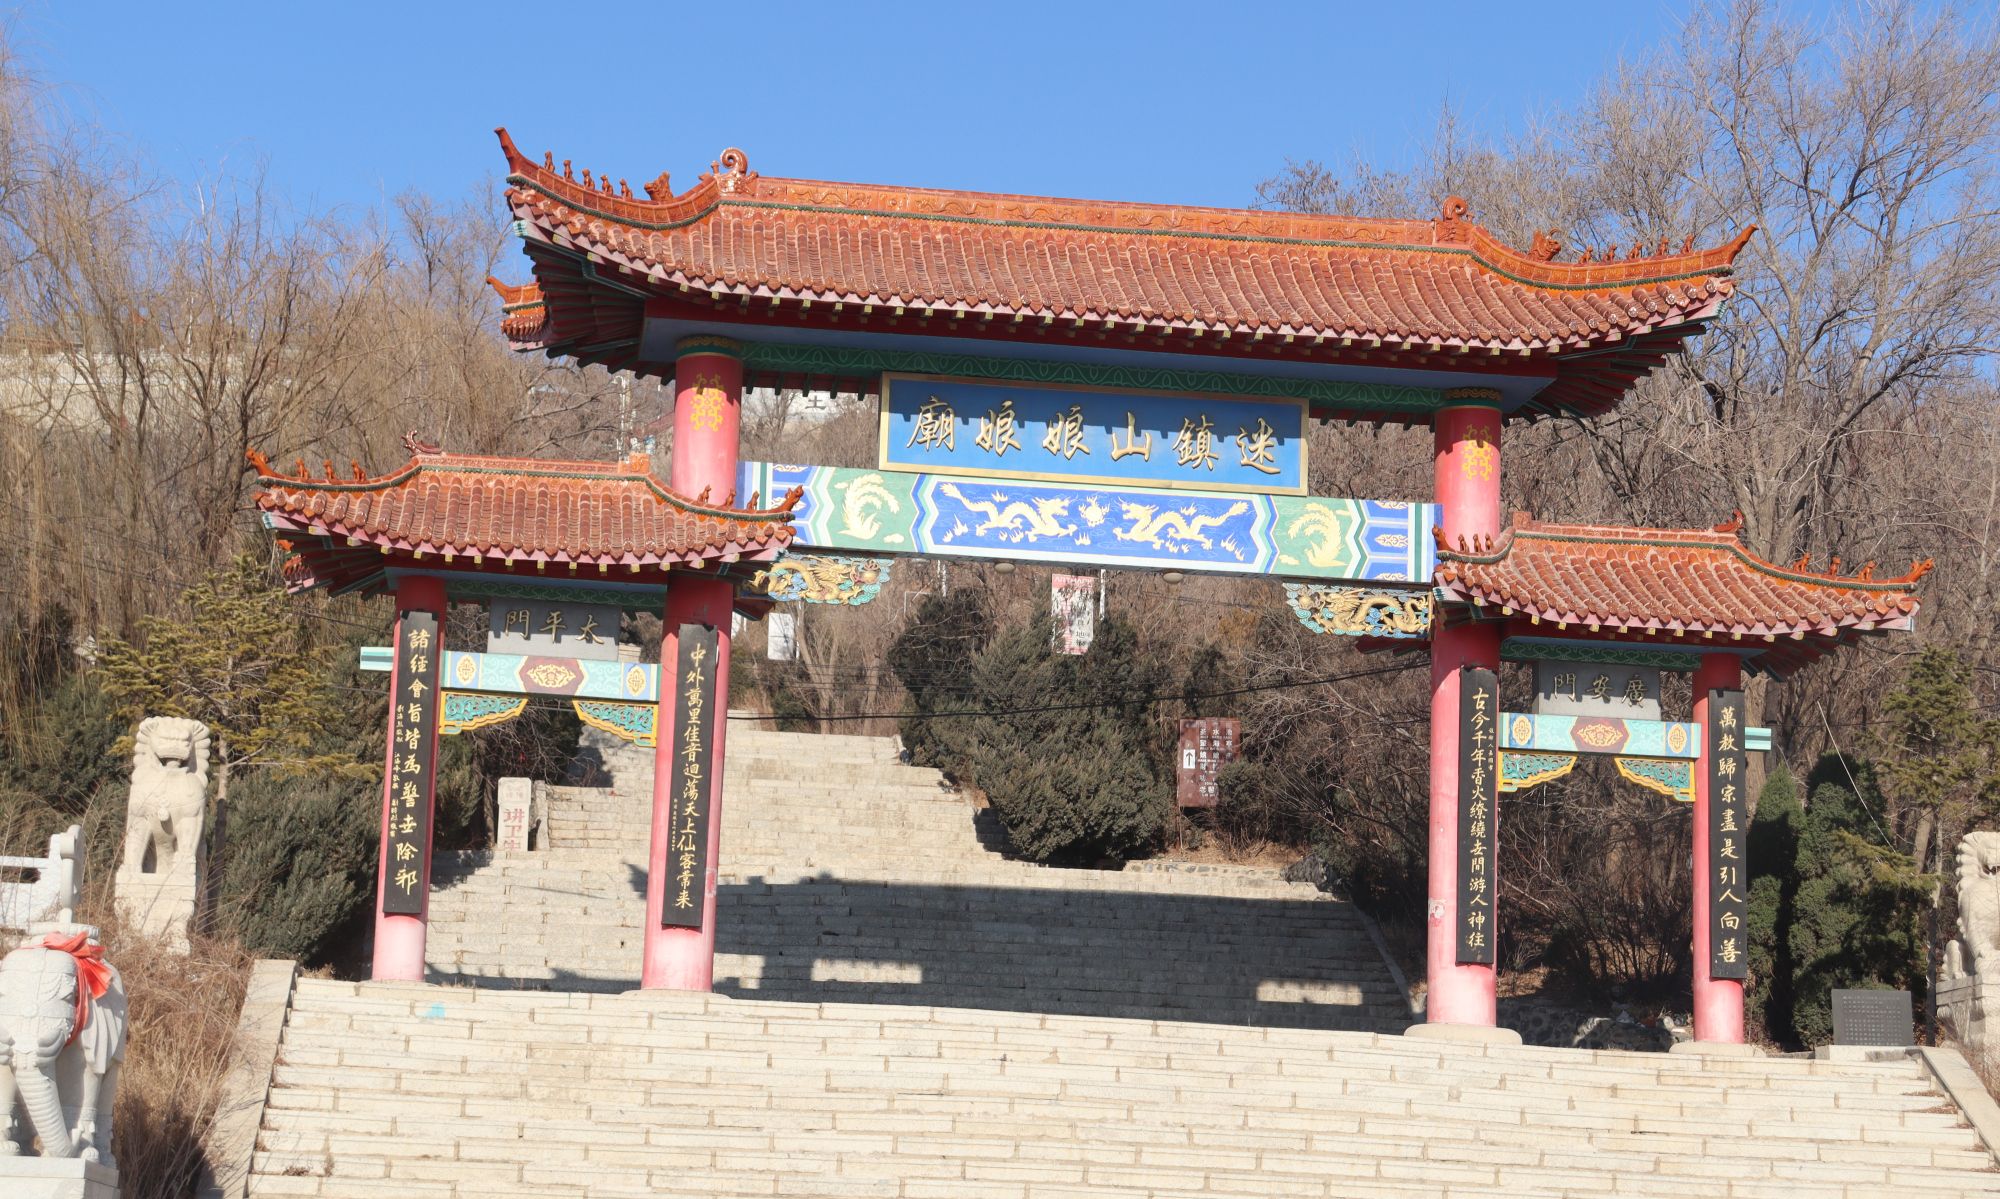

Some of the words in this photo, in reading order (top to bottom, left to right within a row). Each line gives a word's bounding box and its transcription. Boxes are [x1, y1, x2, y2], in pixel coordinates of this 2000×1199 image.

[504, 609, 605, 645] 太平門
[1554, 673, 1649, 709] 廣安門
